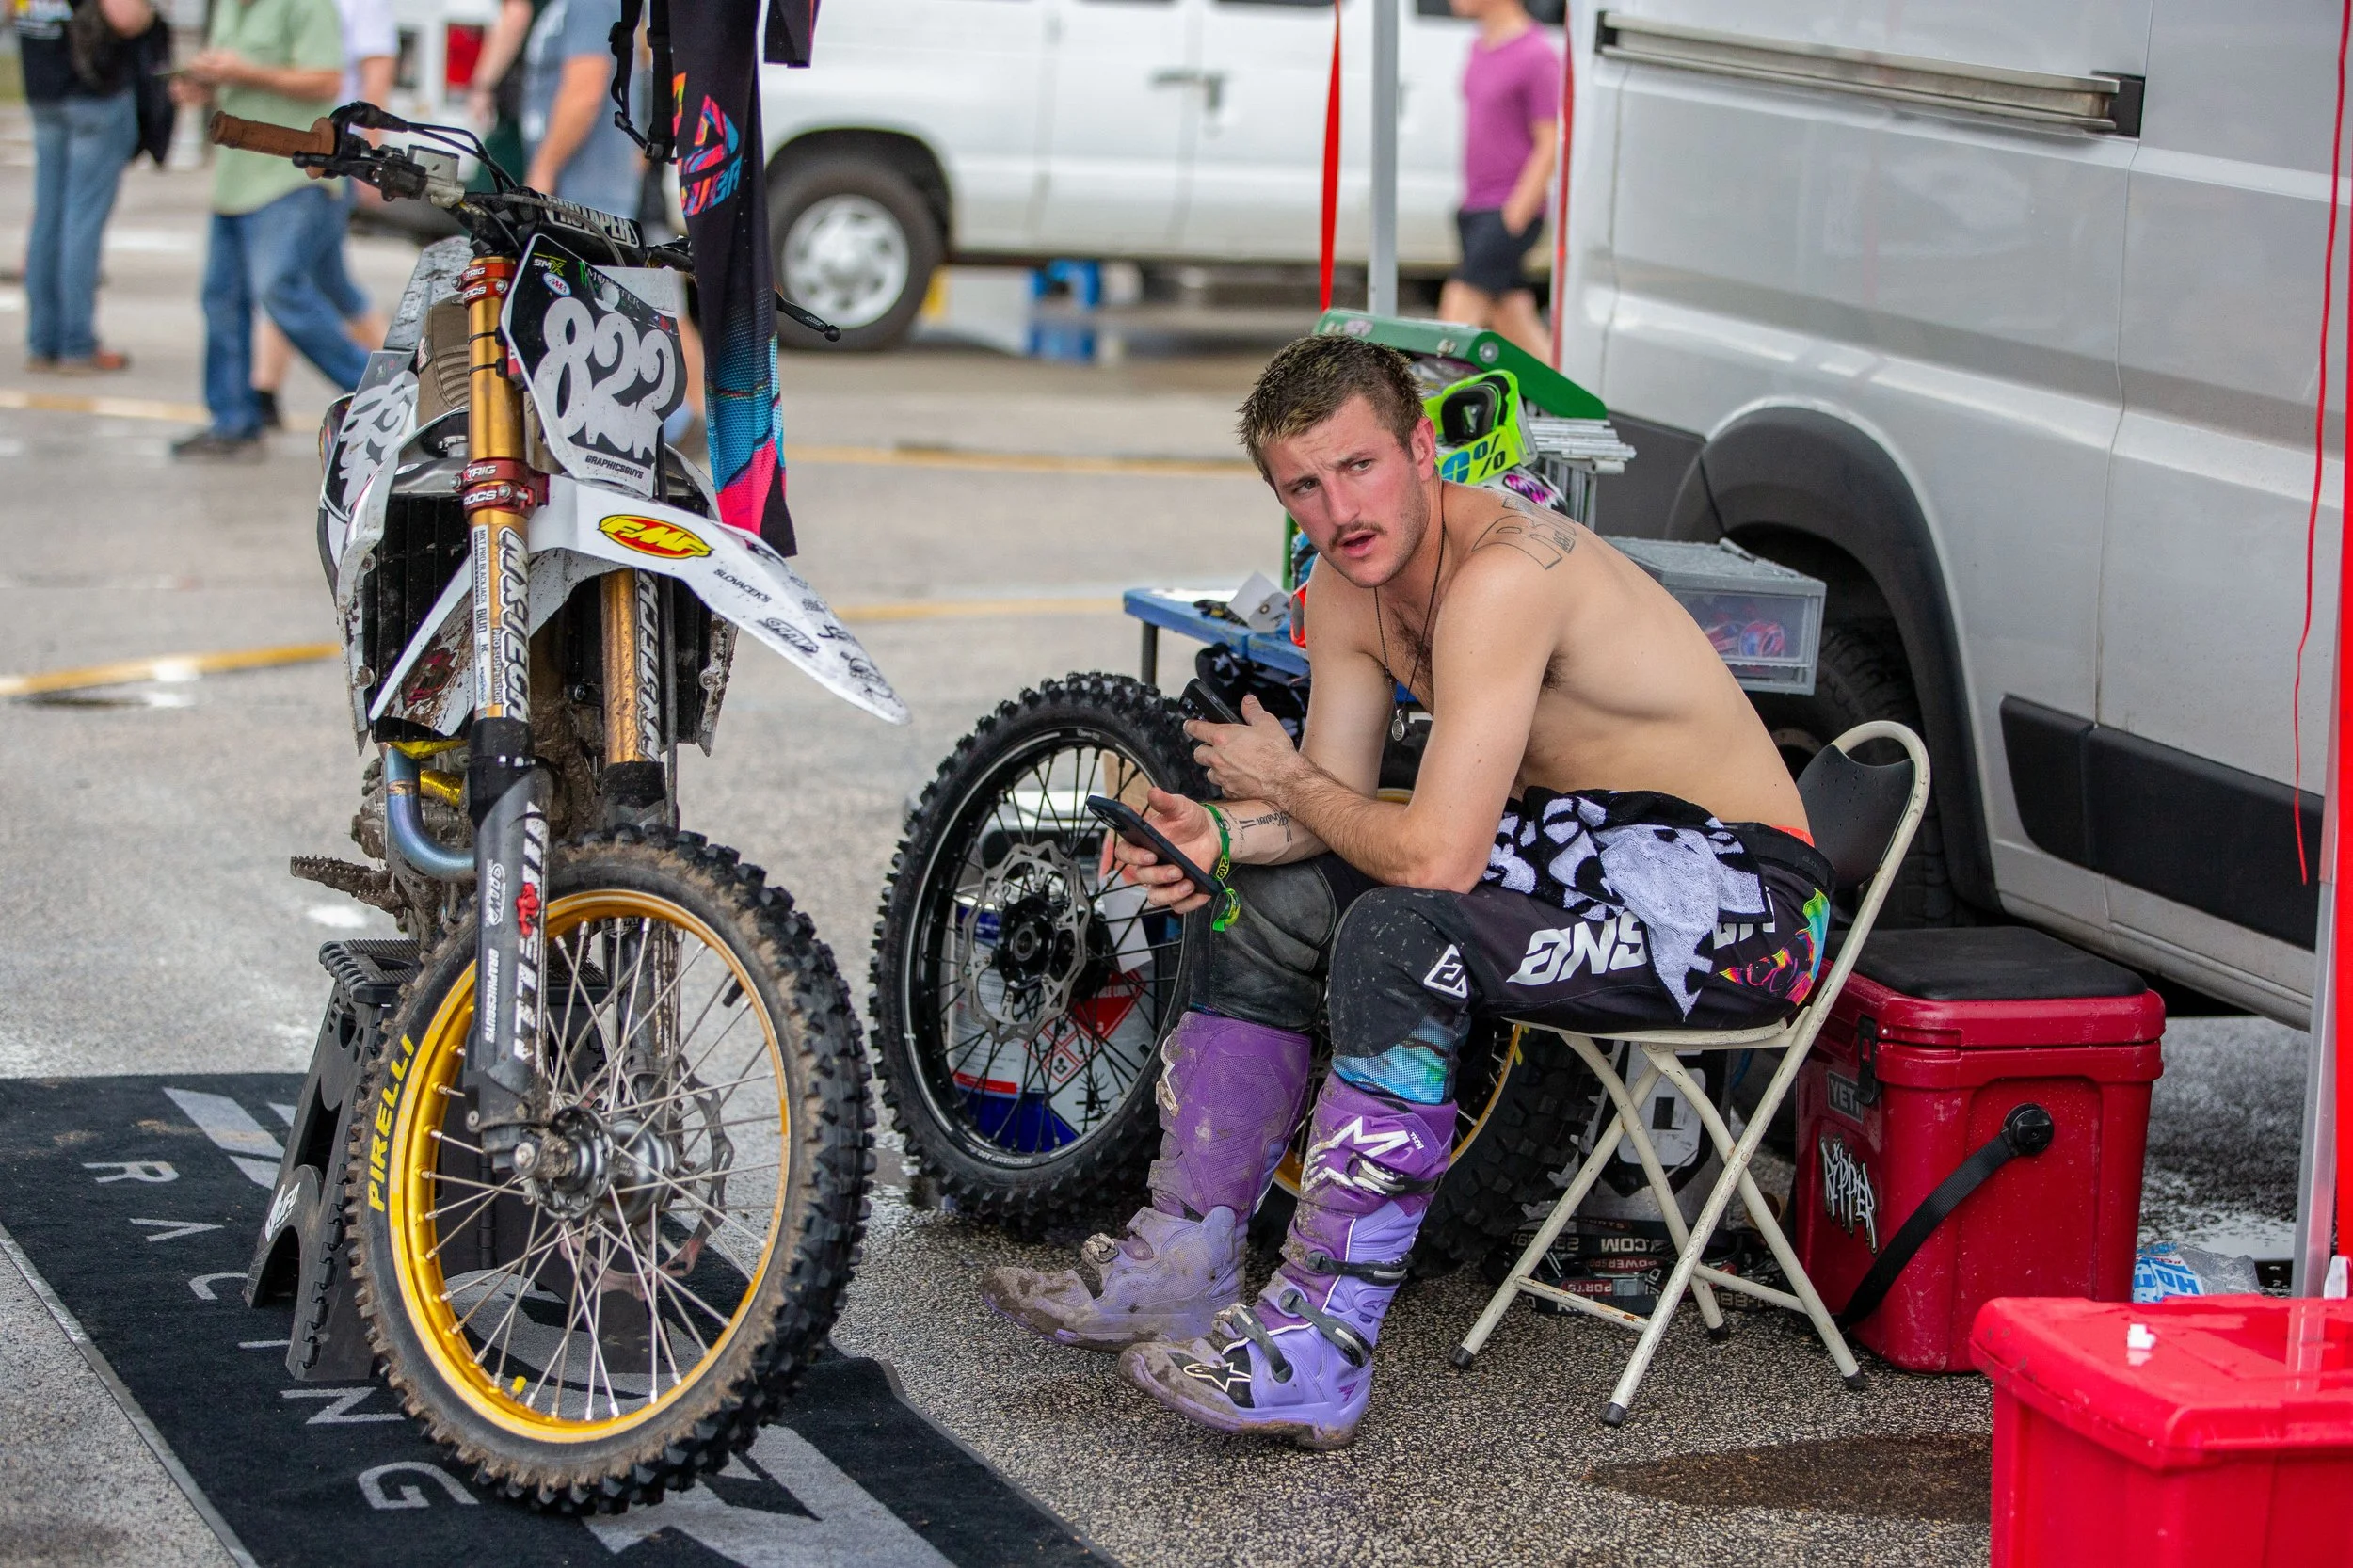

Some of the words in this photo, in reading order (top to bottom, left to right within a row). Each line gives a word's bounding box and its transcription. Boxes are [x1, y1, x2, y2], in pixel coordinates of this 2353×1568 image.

[534, 297, 676, 459] 822
[463, 465, 497, 481] XTRIG
[584, 454, 645, 480] GRAPHICSGUYS
[598, 516, 714, 557] FMF
[480, 564, 488, 605] BLACKJACK
[492, 629, 501, 648] PRO
[492, 648, 504, 704] SUSPENSION
[368, 1033, 415, 1213] PIRELLI
[1820, 1138, 1878, 1253] RIPPER
